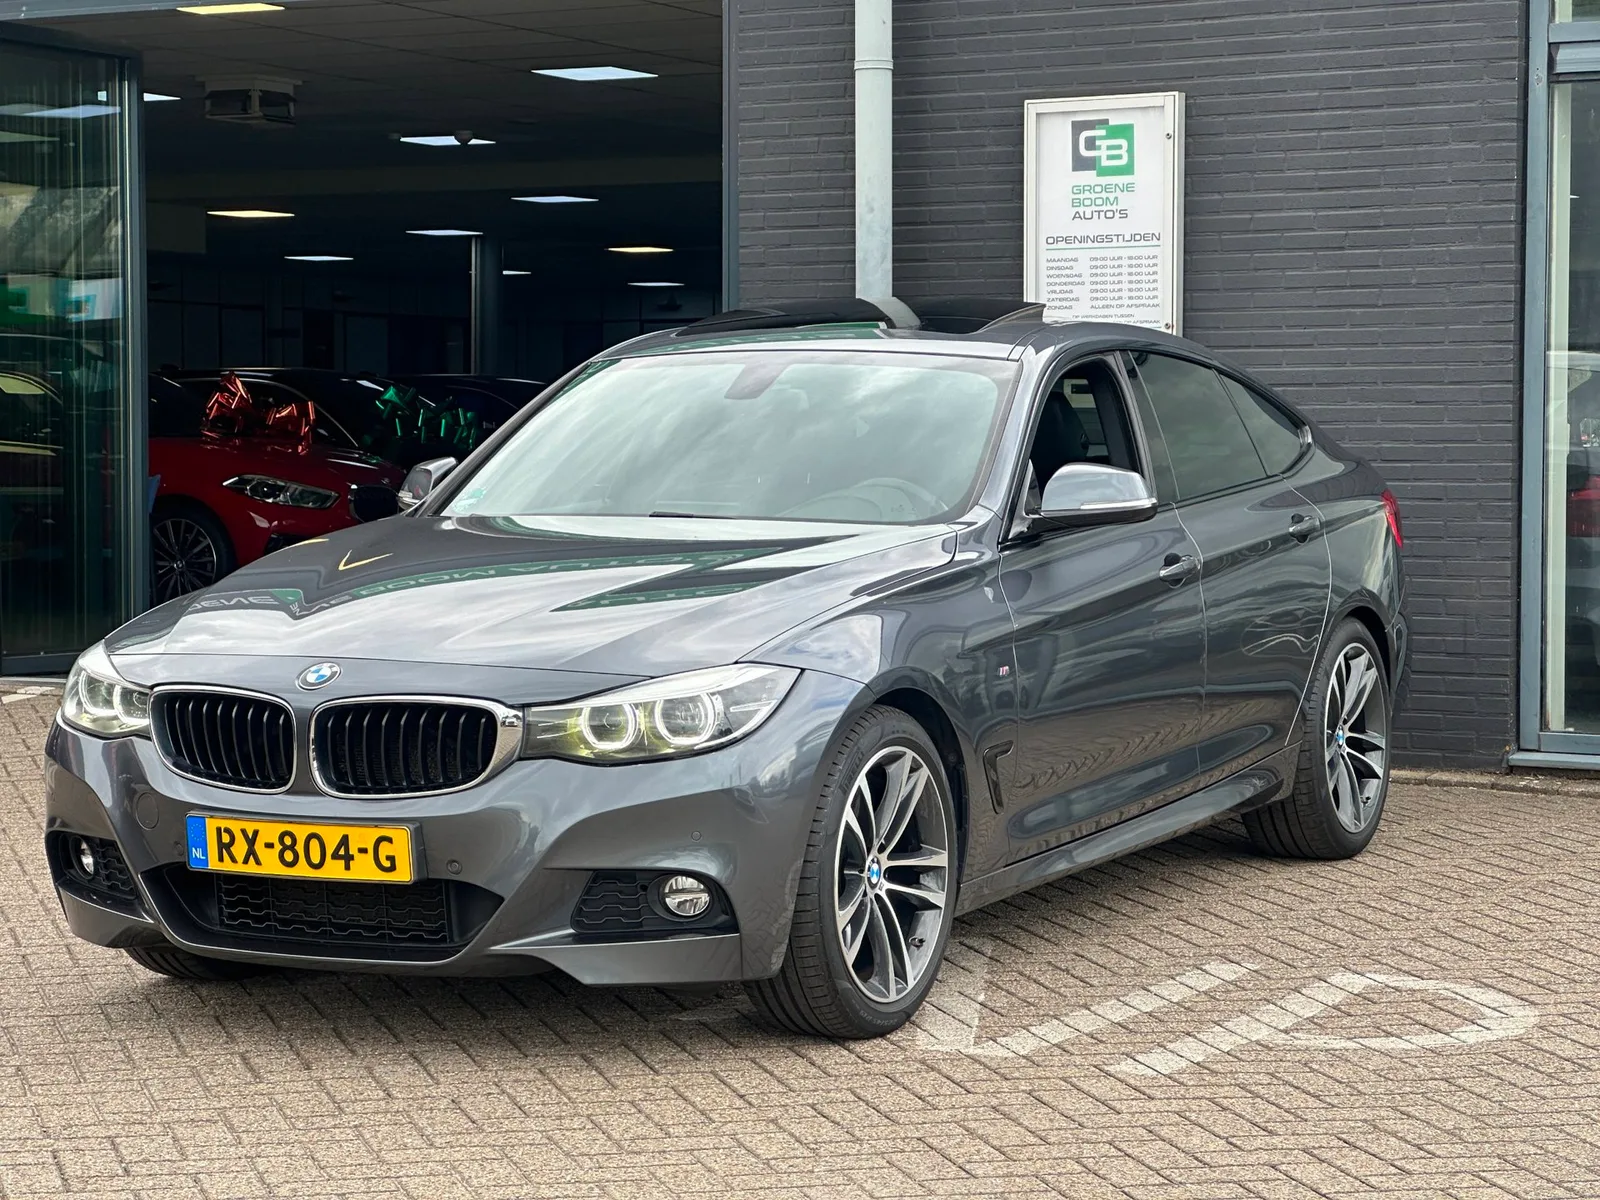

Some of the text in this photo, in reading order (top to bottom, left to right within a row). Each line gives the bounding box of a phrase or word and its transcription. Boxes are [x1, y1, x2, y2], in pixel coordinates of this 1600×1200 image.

[1071, 182, 1136, 195] GROENE
[1071, 196, 1119, 208] BOOM
[1071, 208, 1129, 221] AUTO'S
[1045, 232, 1161, 245] OPENINGSTIJDEN
[192, 847, 206, 860] NL
[215, 825, 398, 873] RX-804-G
